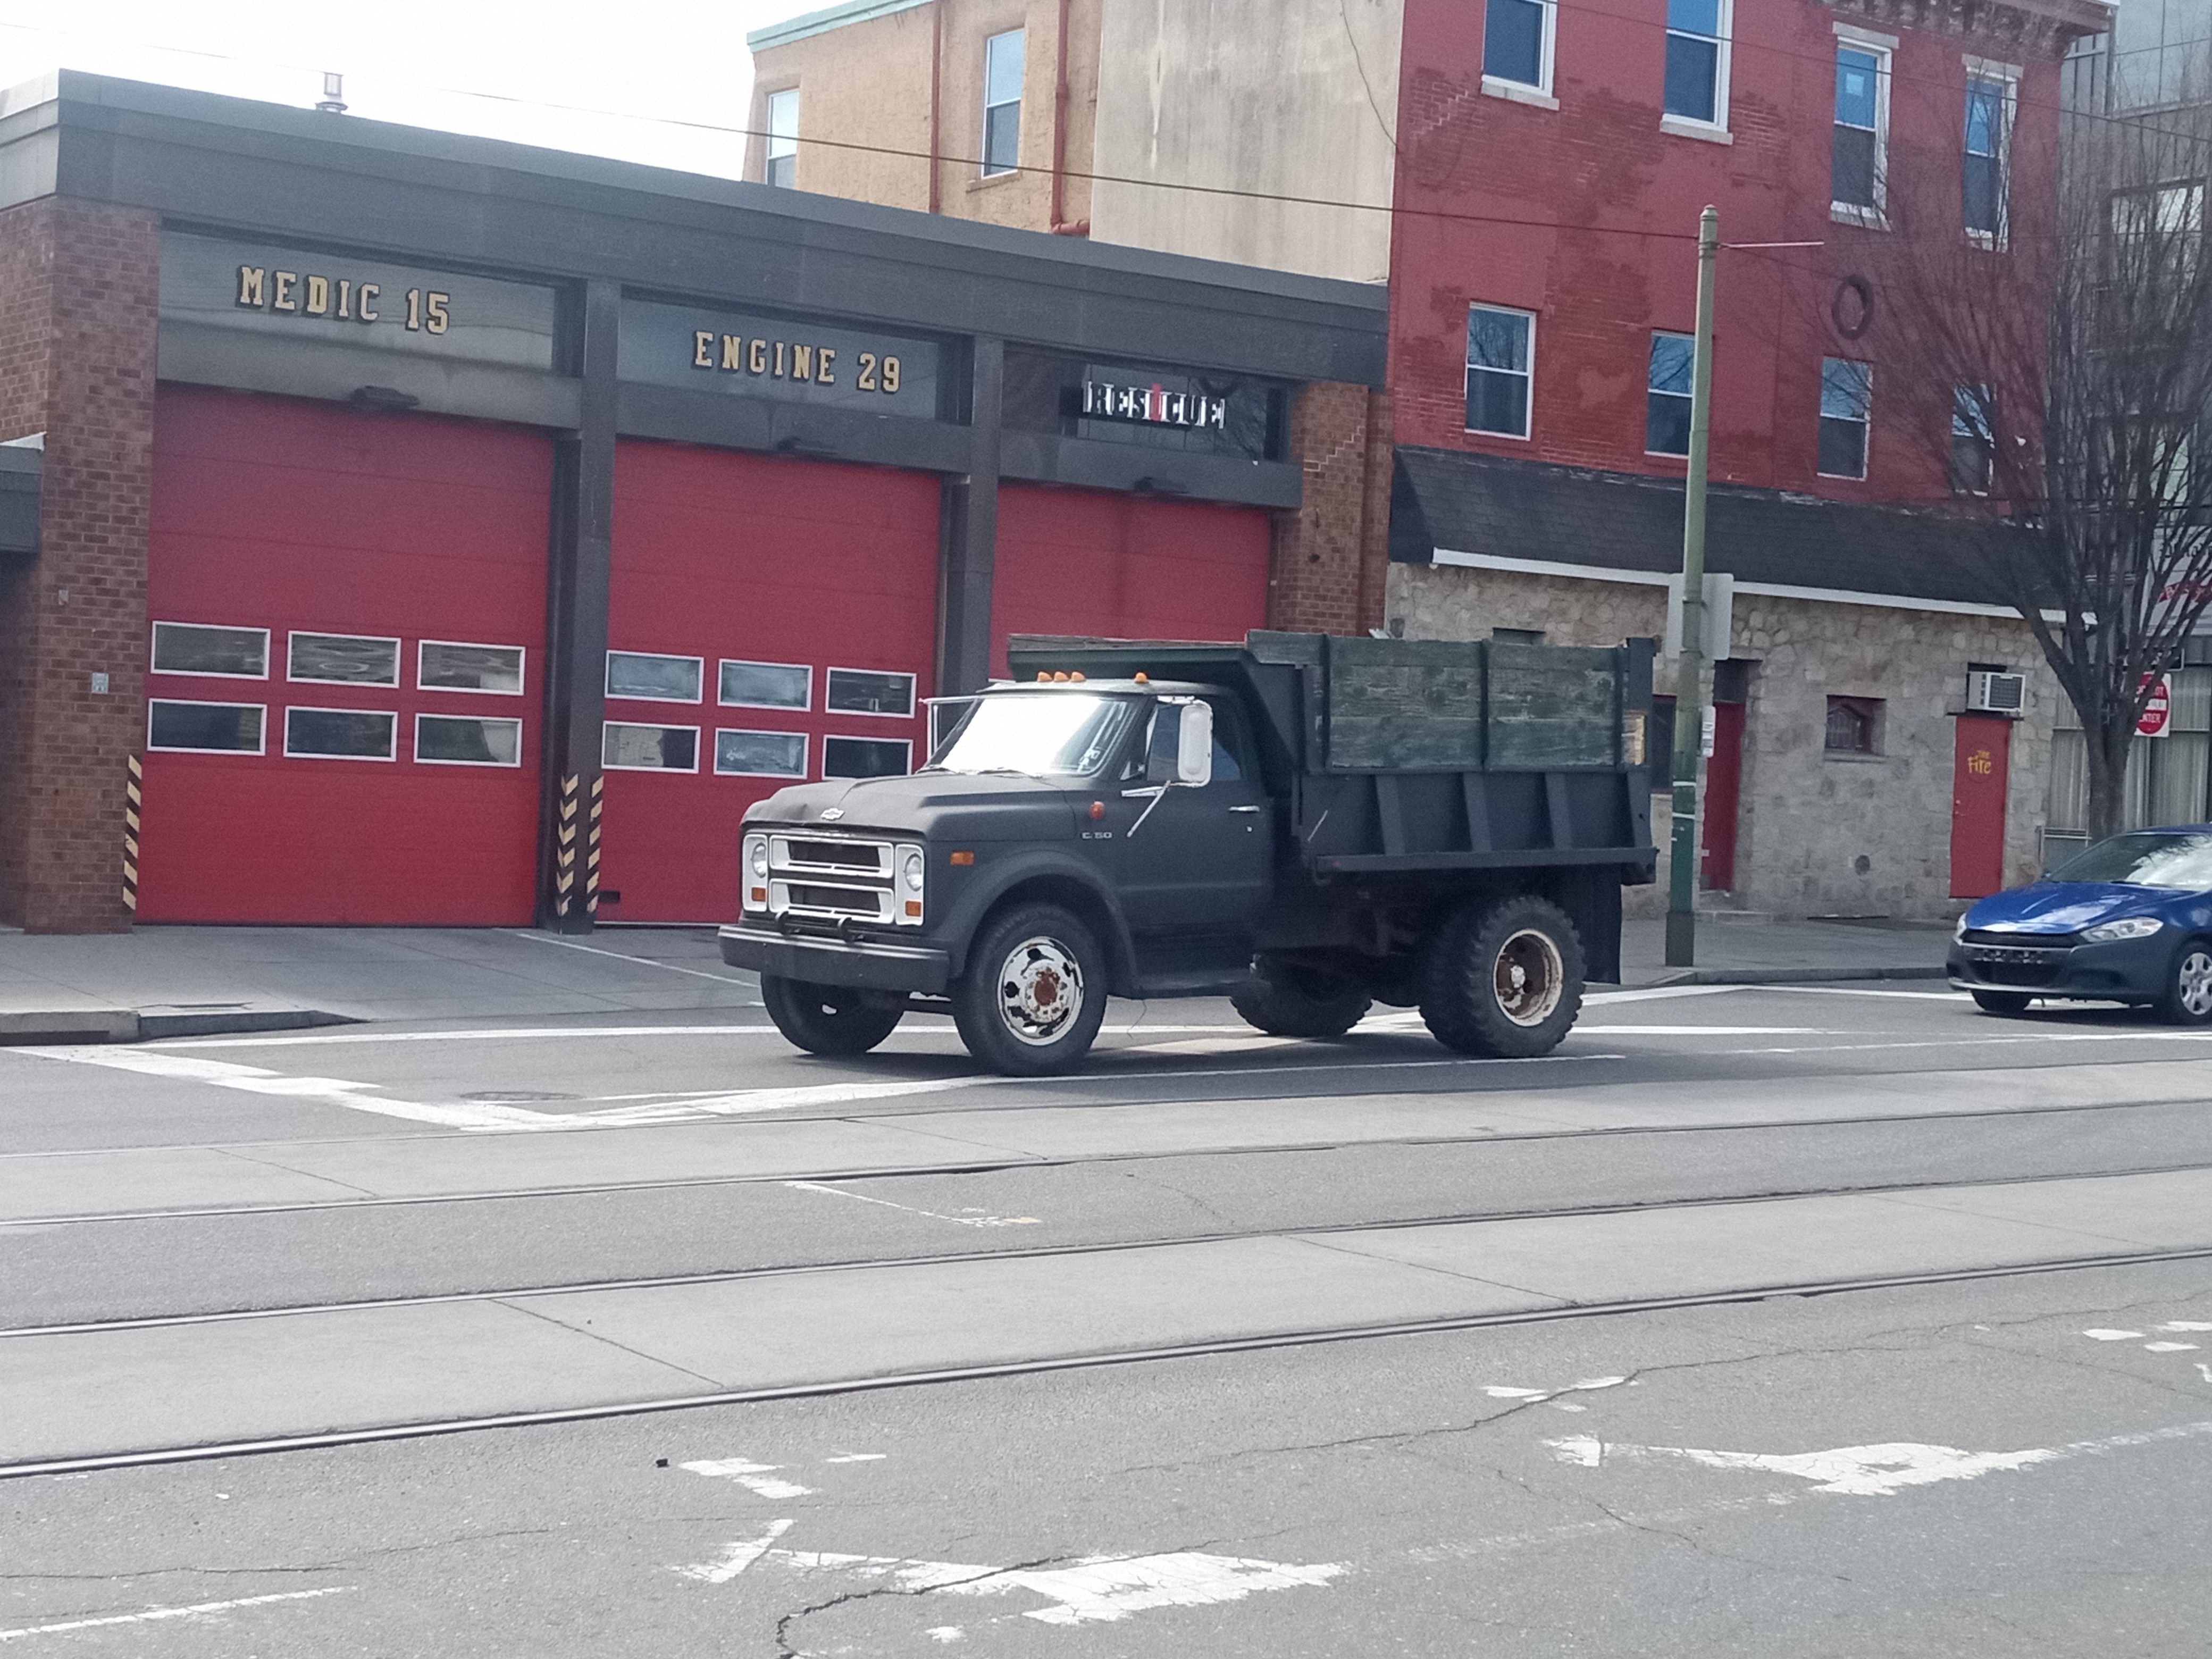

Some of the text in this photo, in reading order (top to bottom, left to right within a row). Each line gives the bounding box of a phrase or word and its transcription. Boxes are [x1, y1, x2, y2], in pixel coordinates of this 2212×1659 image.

[238, 266, 450, 335] MEDIC 15
[694, 331, 901, 392] ENGINE 29
